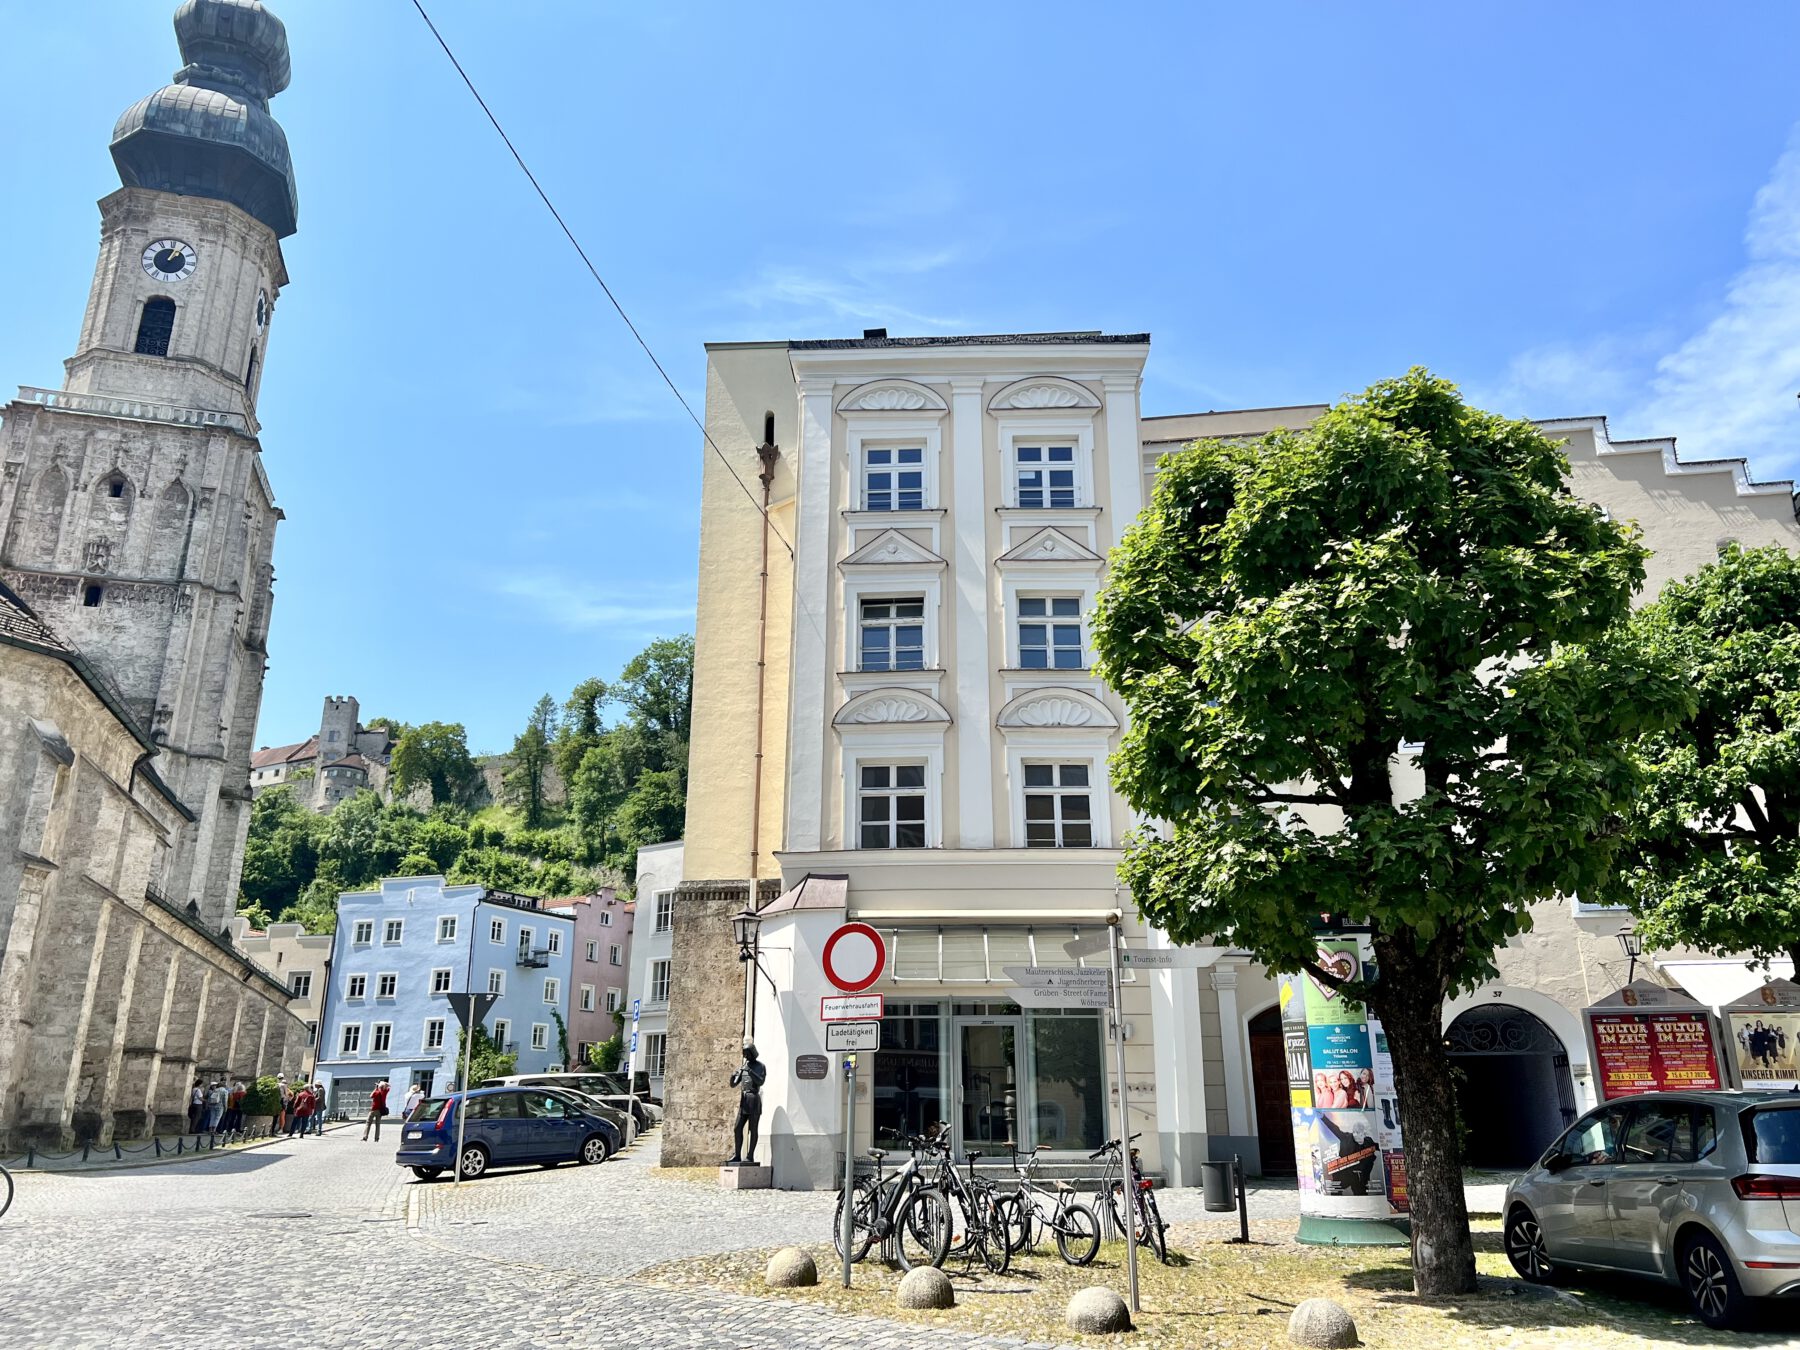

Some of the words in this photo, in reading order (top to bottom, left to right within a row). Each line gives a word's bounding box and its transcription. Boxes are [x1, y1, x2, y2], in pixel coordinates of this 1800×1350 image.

[1076, 968, 1106, 976] Jazzkeller
[1058, 978, 1106, 987] Jugendherberge
[825, 1002, 878, 1010] Feuerwehrausfahrt
[1596, 1024, 1648, 1033] KULTUR
[1653, 1023, 1705, 1033] KULTUR
[831, 1029, 873, 1037] Ladetätigkeit
[1657, 1033, 1673, 1042] IM
[1676, 1033, 1704, 1042] ZELT
[1601, 1034, 1617, 1043] IM
[1619, 1034, 1647, 1043] ZELT
[1288, 1052, 1309, 1080] JAM
[1741, 1070, 1774, 1080] KINSEHER
[1775, 1069, 1798, 1079] KIMMT
